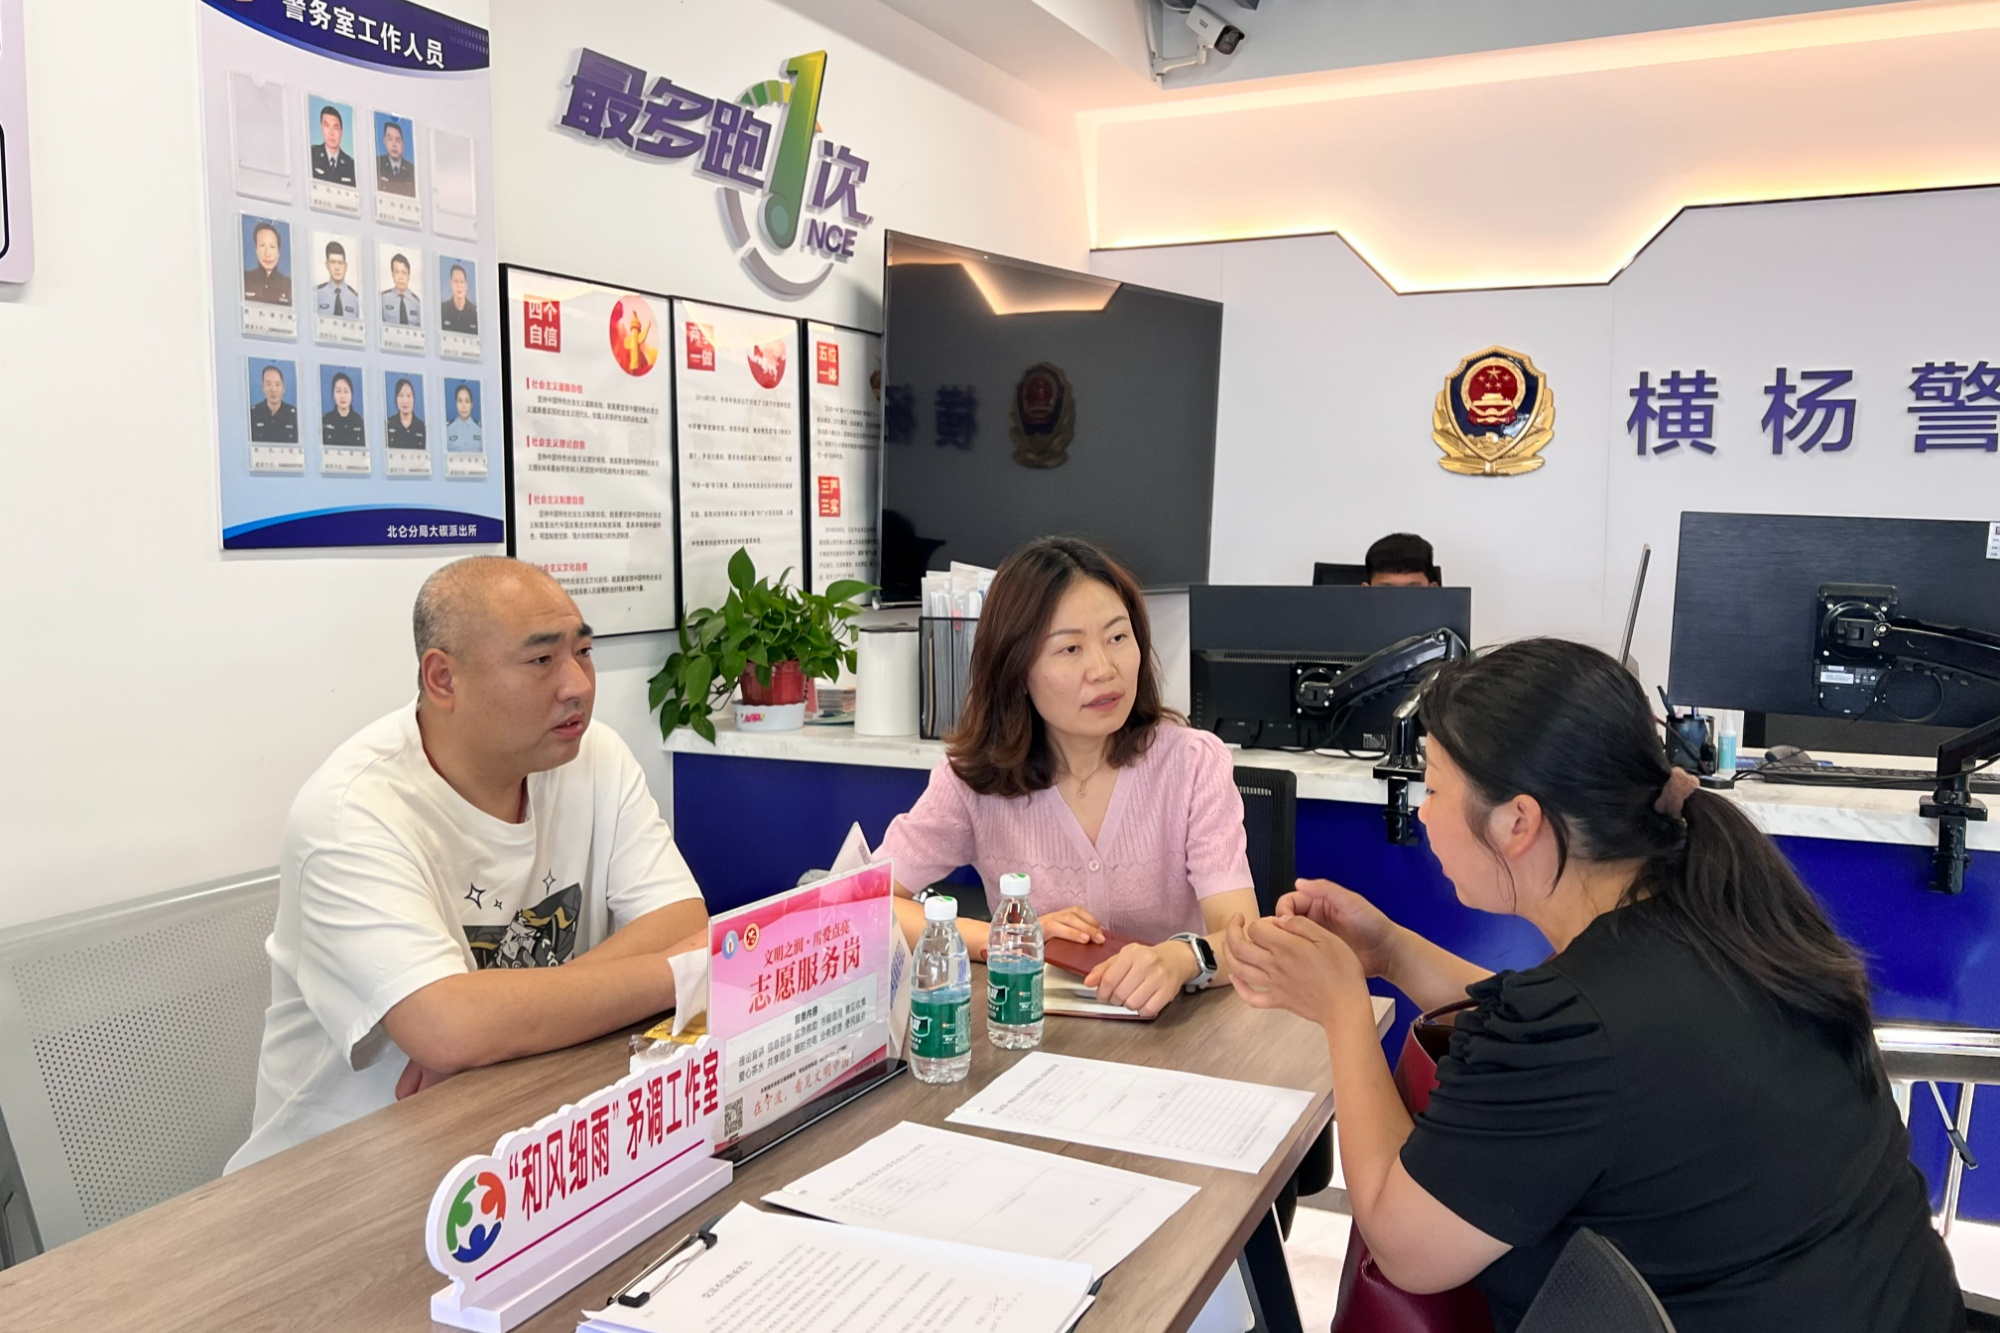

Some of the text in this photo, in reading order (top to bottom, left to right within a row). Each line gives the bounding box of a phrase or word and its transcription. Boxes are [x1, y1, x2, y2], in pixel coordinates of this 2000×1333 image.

[282, 0, 445, 69] 警务室工作人员
[528, 300, 558, 323] 四个
[529, 323, 558, 348] 自信
[689, 348, 713, 367] 一做
[818, 344, 837, 364] 五位
[818, 368, 837, 383] 一体
[1626, 360, 2000, 456] 横杨警
[820, 479, 839, 495] 三严
[820, 498, 839, 515] 三实
[387, 524, 478, 538] 北仑分局大碶派出所
[748, 935, 861, 1015] 志愿服务岗
[794, 1005, 819, 1025] 服务内容
[738, 1046, 765, 1067] 理论宣讲
[767, 1033, 792, 1053] 信息咨询
[794, 1020, 818, 1040] 应急救助
[845, 997, 867, 1014] 意见收集
[738, 1062, 765, 1083] 爱心茶水
[767, 1049, 792, 1068] 共享雨伞
[794, 1035, 818, 1055] 随时充电
[820, 1023, 843, 1041] 业务受理
